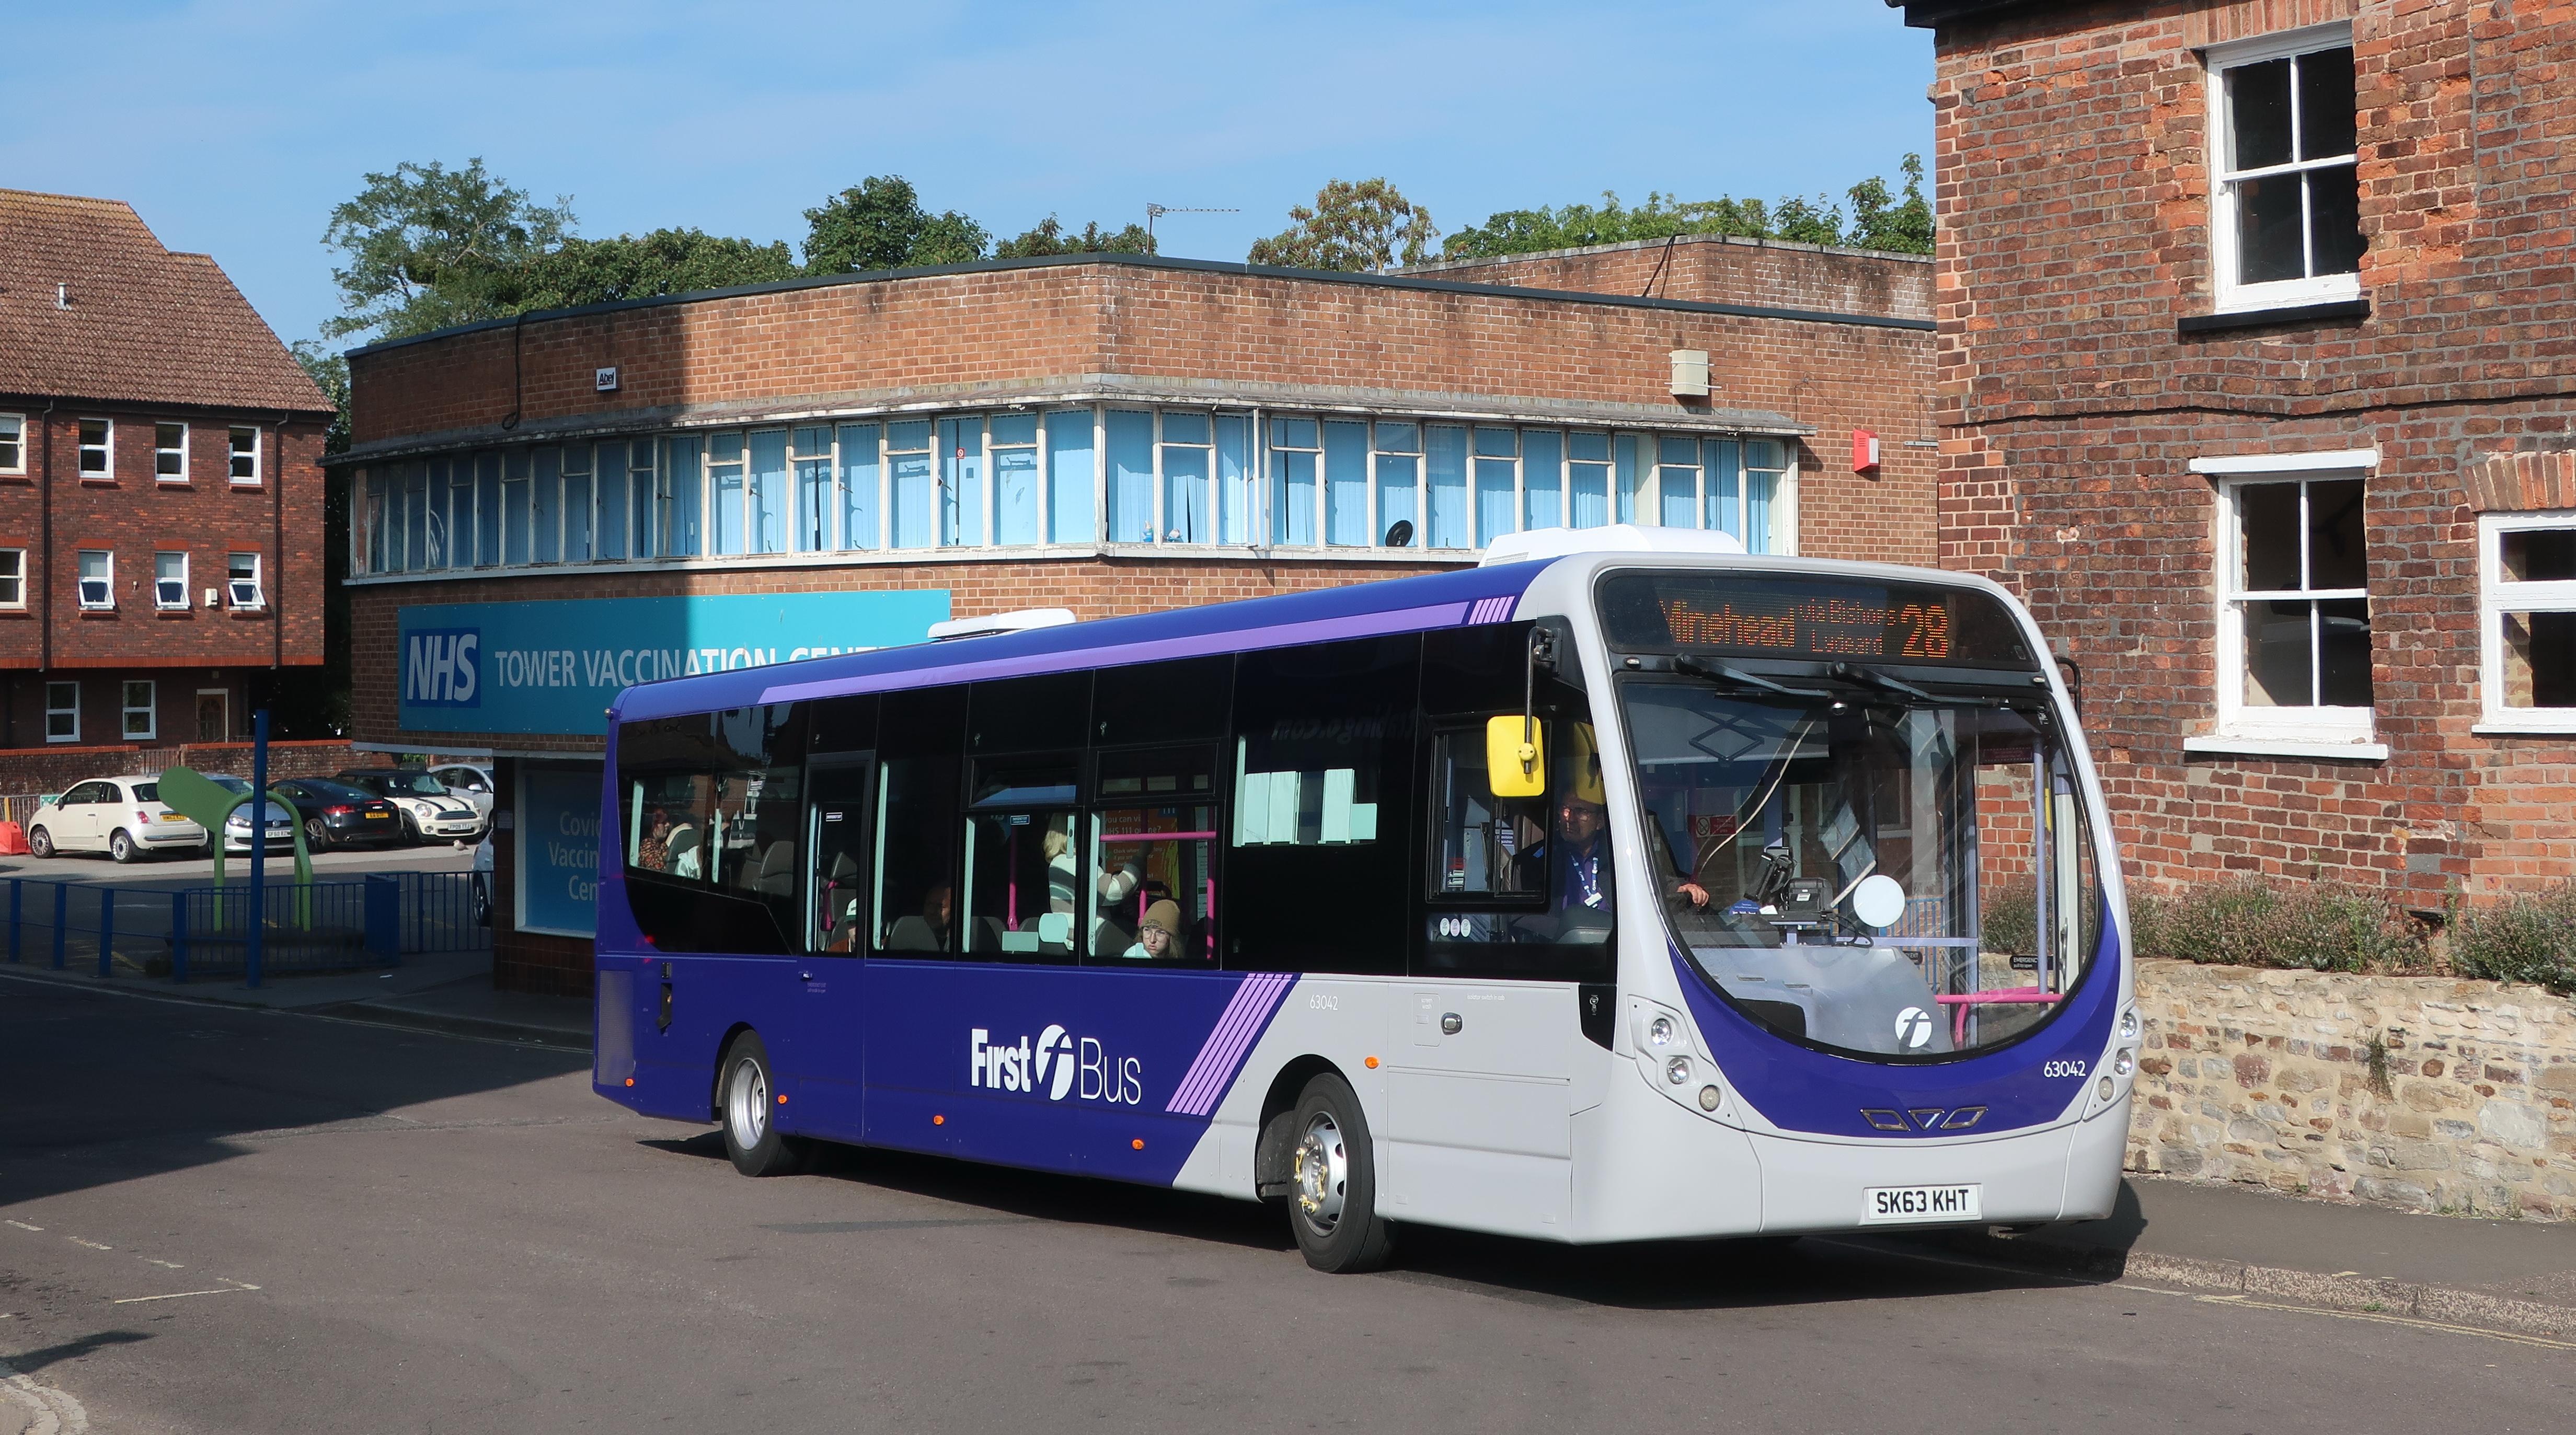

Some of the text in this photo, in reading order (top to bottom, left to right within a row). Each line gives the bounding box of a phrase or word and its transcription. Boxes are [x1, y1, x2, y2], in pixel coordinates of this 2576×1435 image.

[1800, 599, 1825, 622] via
[1901, 605, 1948, 657] 28
[407, 633, 478, 702] NHS
[495, 650, 577, 688] TOWER
[548, 841, 600, 869] Vaccin
[569, 874, 598, 901] Cen
[1309, 994, 1338, 1011] 63042
[971, 1028, 1031, 1092] First
[1080, 1037, 1142, 1105] Bus
[2043, 1061, 2086, 1078] 63042
[1877, 1189, 1969, 1214] SK63 KHT
